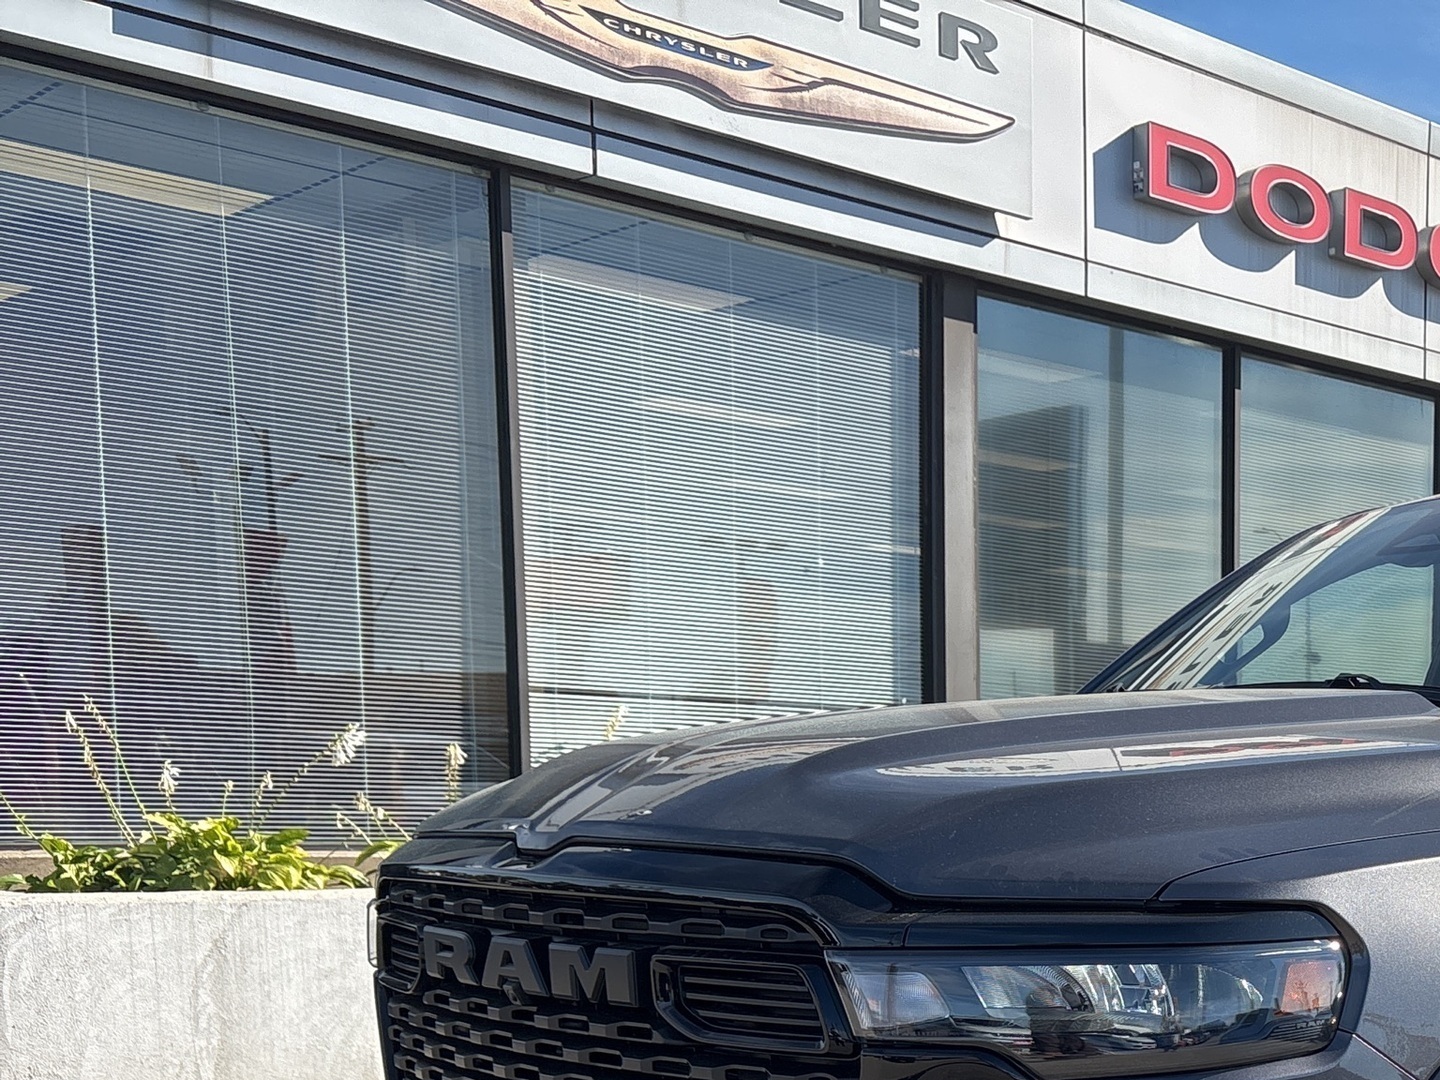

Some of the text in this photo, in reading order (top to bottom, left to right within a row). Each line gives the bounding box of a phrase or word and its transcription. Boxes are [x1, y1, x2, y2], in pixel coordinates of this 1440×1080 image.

[603, 18, 749, 69] CHRYSLER
[777, 0, 1000, 75] ER
[423, 925, 639, 1007] RAM
